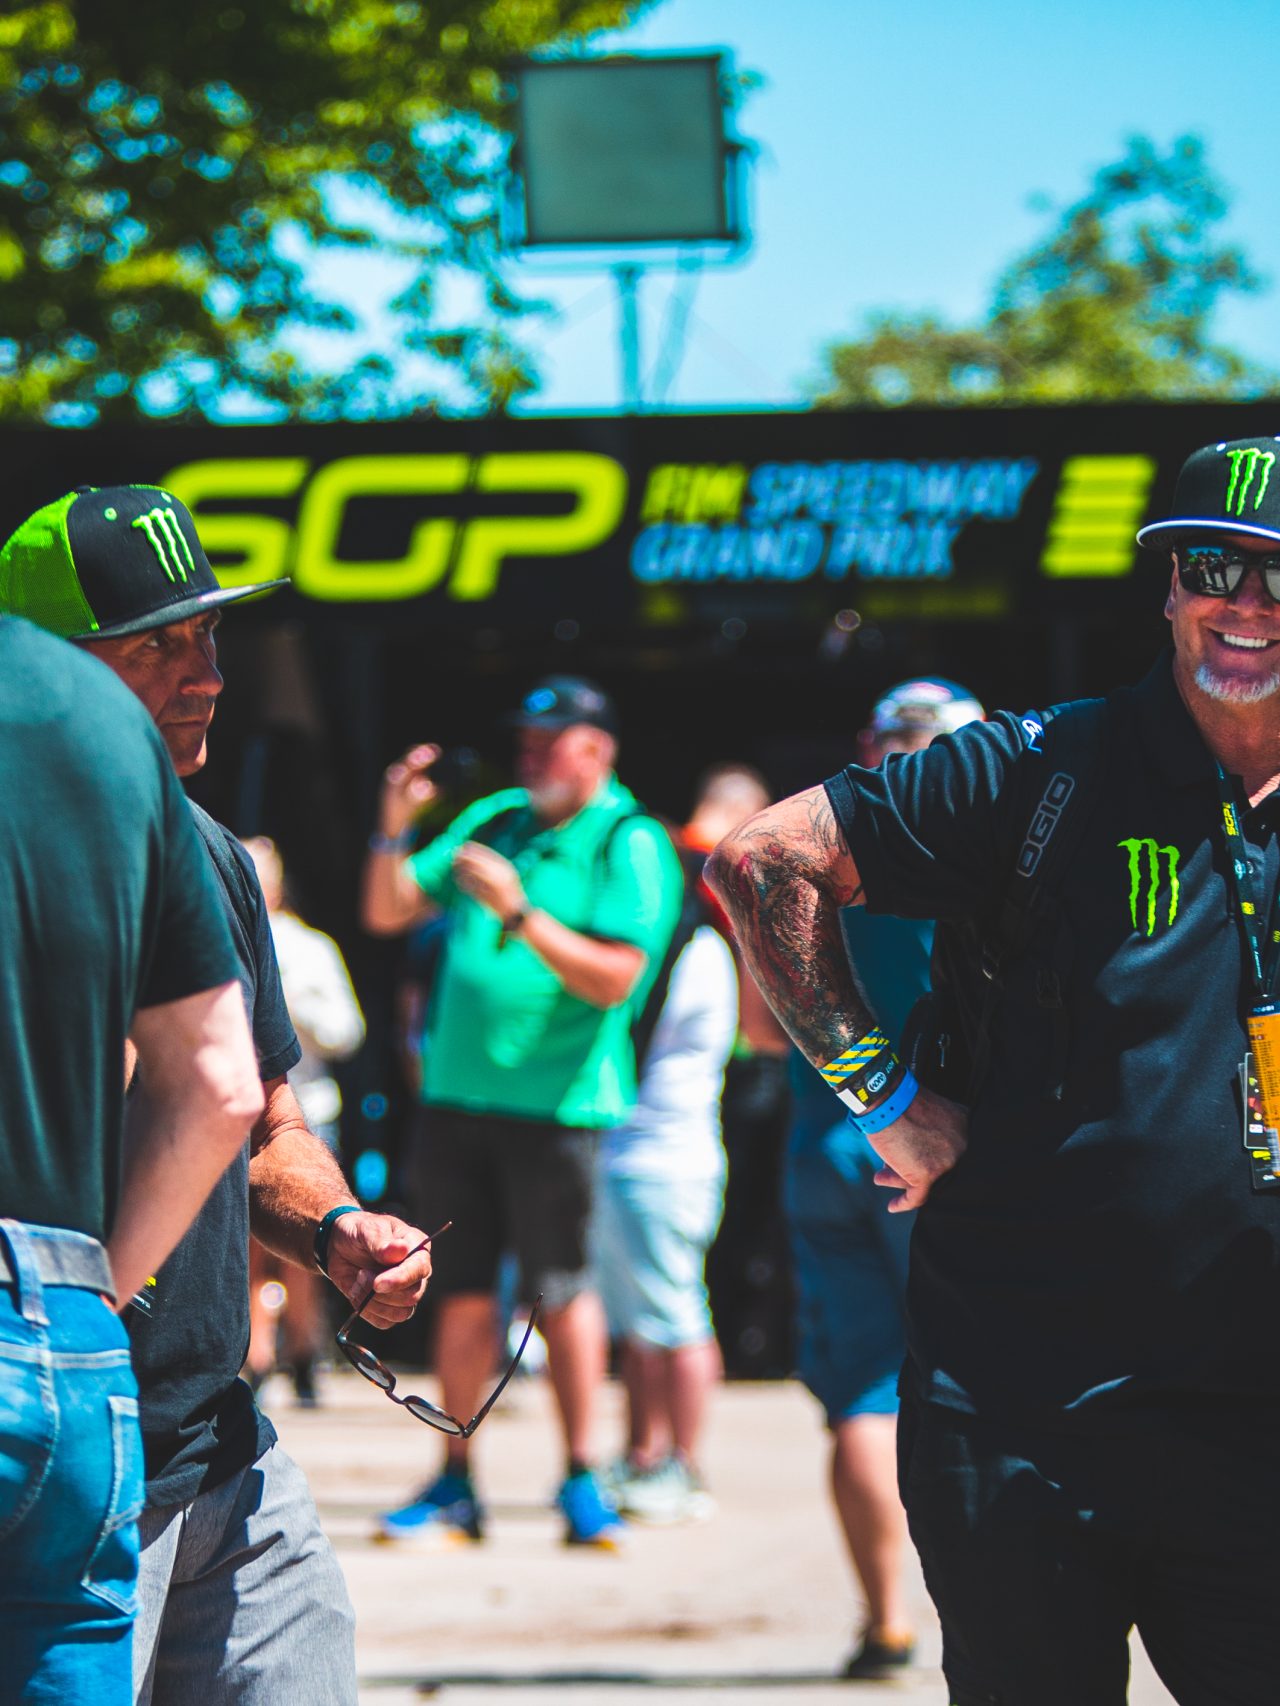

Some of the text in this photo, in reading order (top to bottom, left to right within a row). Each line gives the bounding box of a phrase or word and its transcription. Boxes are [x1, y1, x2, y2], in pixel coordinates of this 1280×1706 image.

[746, 459, 1038, 527] SPEEDWAY
[630, 522, 961, 583] GRAND PRIX
[1016, 772, 1076, 877] OGIO
